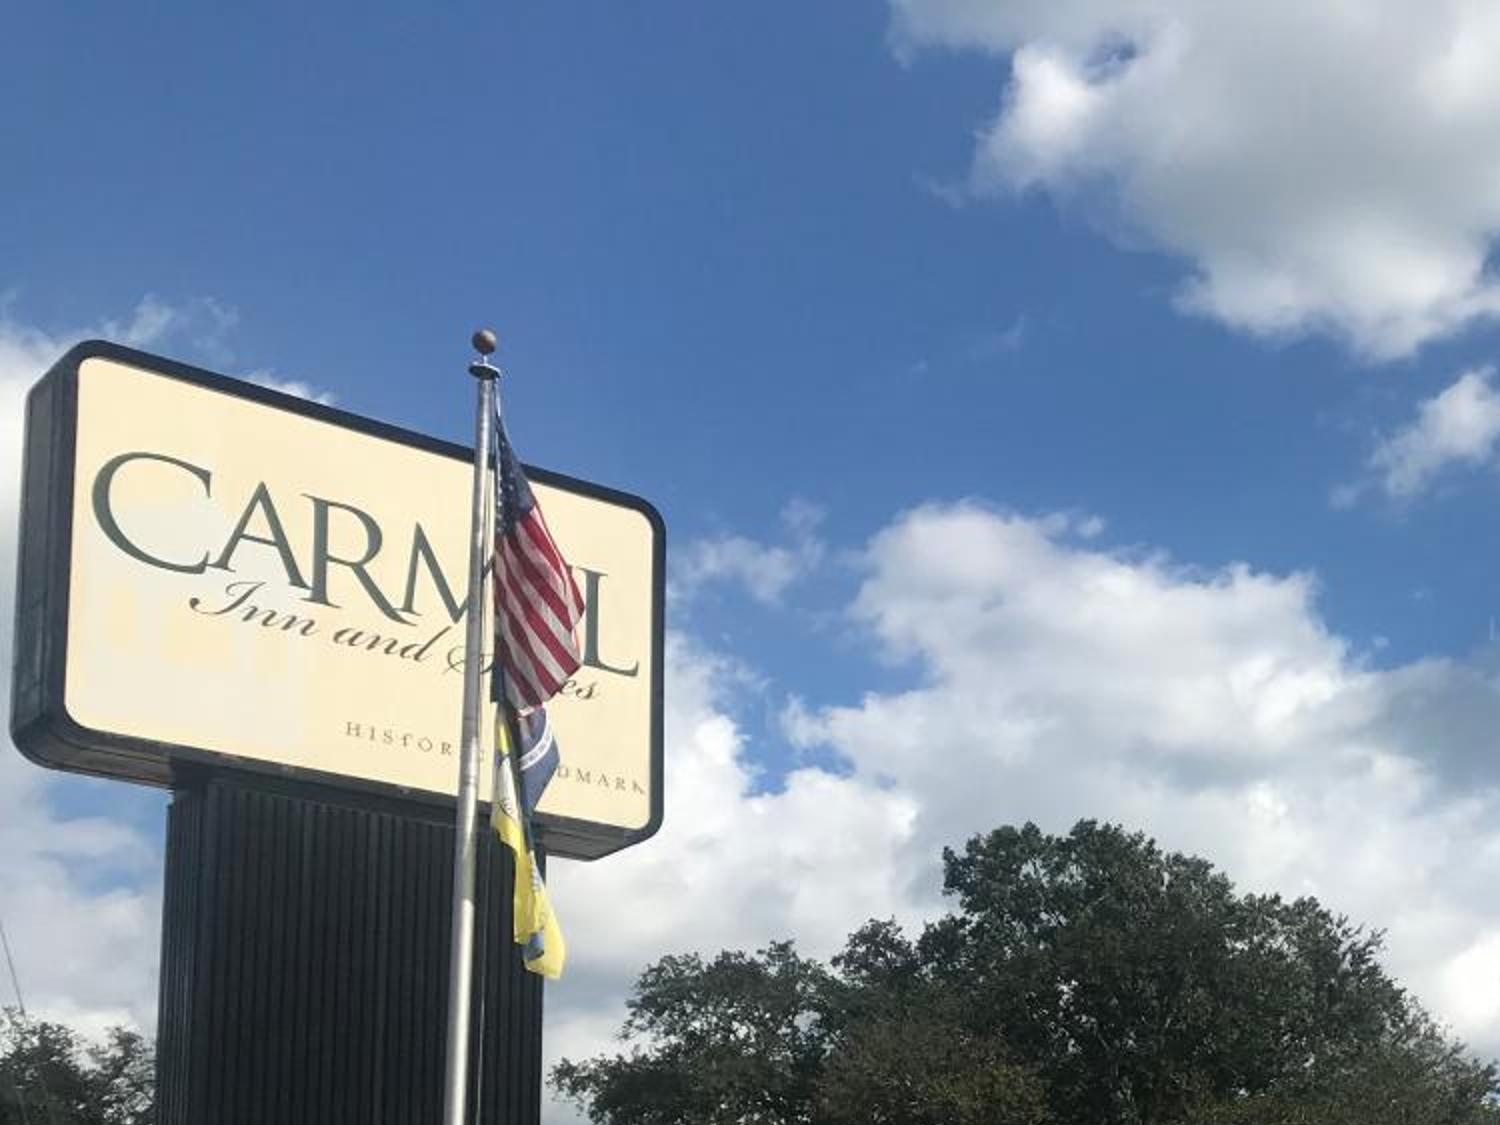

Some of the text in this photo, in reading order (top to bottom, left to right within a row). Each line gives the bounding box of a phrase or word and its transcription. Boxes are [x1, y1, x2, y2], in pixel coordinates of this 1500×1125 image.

[91, 452, 640, 677] CARML
[189, 581, 319, 637] Inn
[332, 625, 451, 662] and
